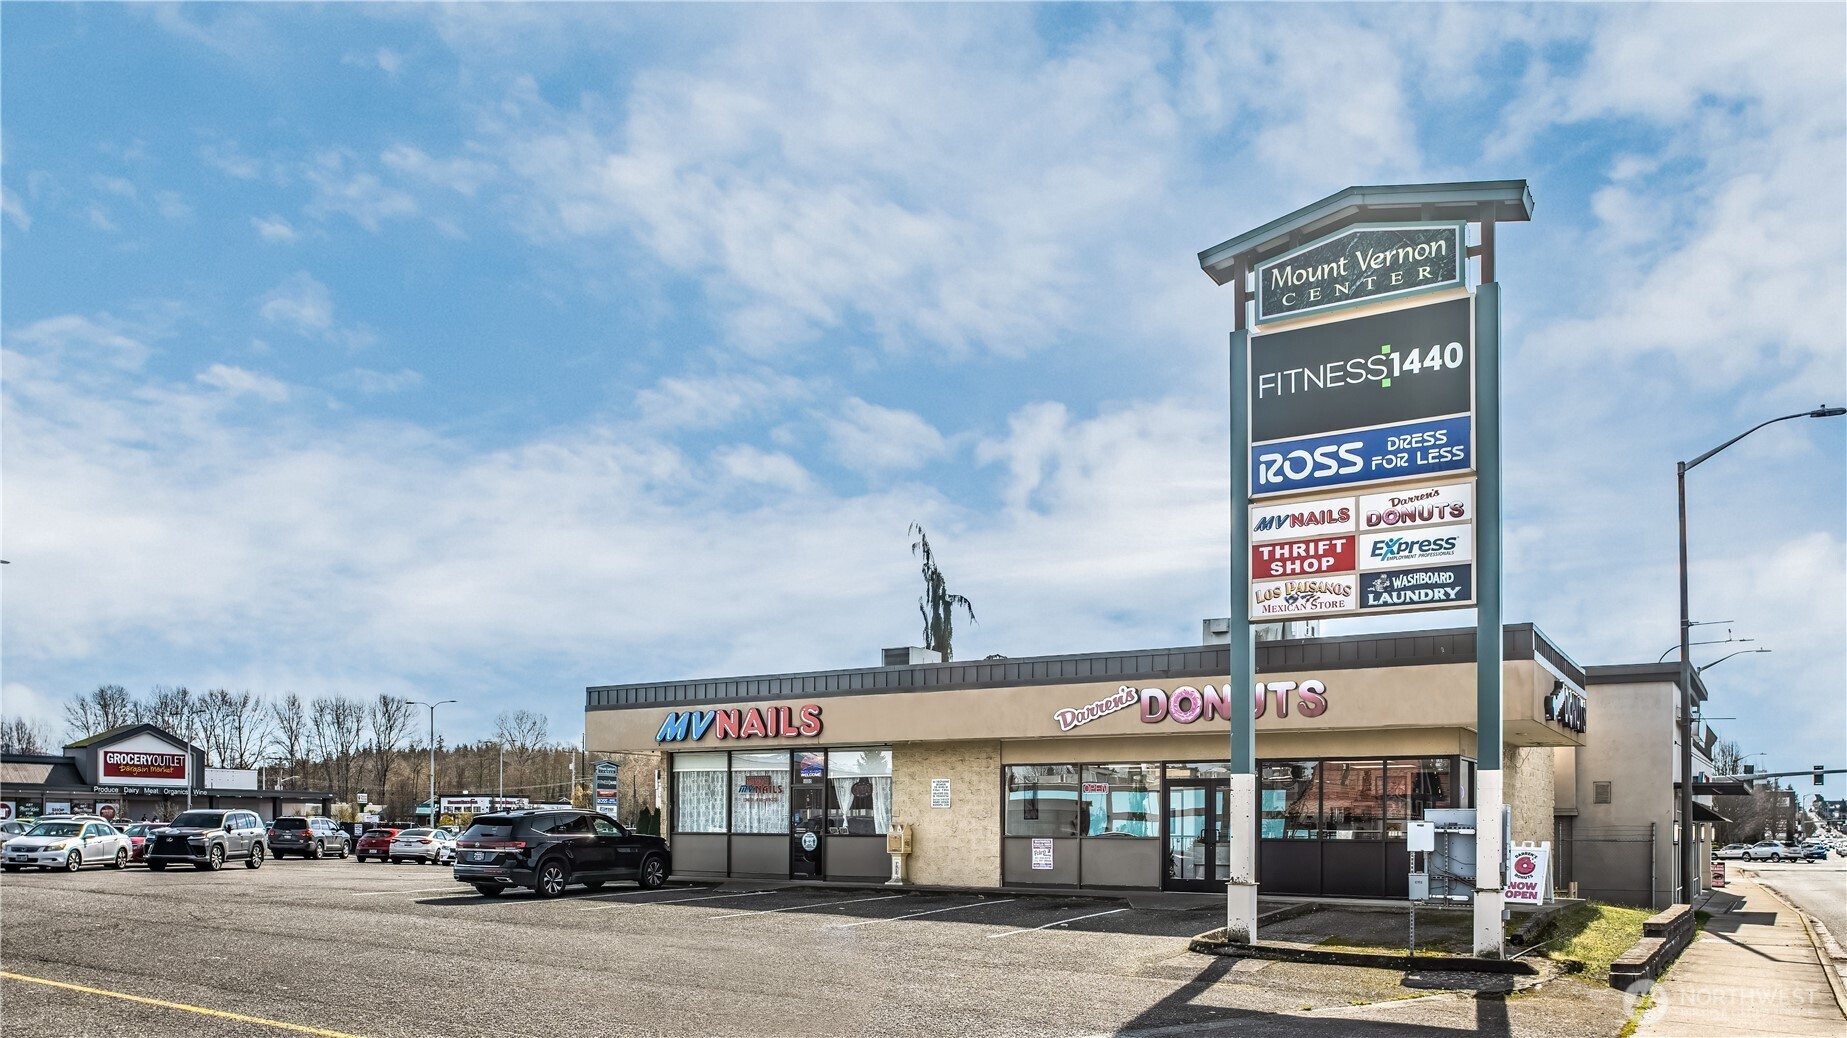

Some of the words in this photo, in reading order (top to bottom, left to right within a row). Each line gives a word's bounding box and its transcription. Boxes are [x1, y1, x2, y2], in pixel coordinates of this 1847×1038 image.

[1271, 258, 1348, 290] Mount
[1356, 239, 1446, 271] Vernon
[1282, 266, 1433, 306] CENTER
[1387, 429, 1448, 451] DRESS
[1259, 441, 1364, 485] ROSS
[1371, 452, 1409, 471] FOR
[1416, 445, 1465, 465] LESS
[1388, 488, 1440, 508] Darren's
[1366, 500, 1465, 527] DONUTS
[1258, 538, 1347, 560] THRIFT
[1386, 553, 1418, 562] EMPLOYMENT
[1418, 550, 1455, 559] PROFESSIONALS
[1270, 556, 1335, 576] SHOP
[1392, 571, 1455, 590] WASHBOARD
[1367, 586, 1462, 606] LAUNDRY
[1261, 603, 1307, 614] MEXICAN
[1310, 600, 1346, 610] STORE
[1054, 685, 1138, 732] Darren's
[93, 785, 119, 794] Produce
[123, 786, 140, 795] Dairy
[163, 788, 189, 796] Organics
[193, 788, 208, 796] Wine
[1084, 784, 1107, 793] OPEN
[1504, 889, 1538, 900] OPEN
[1508, 881, 1538, 891] NOW
